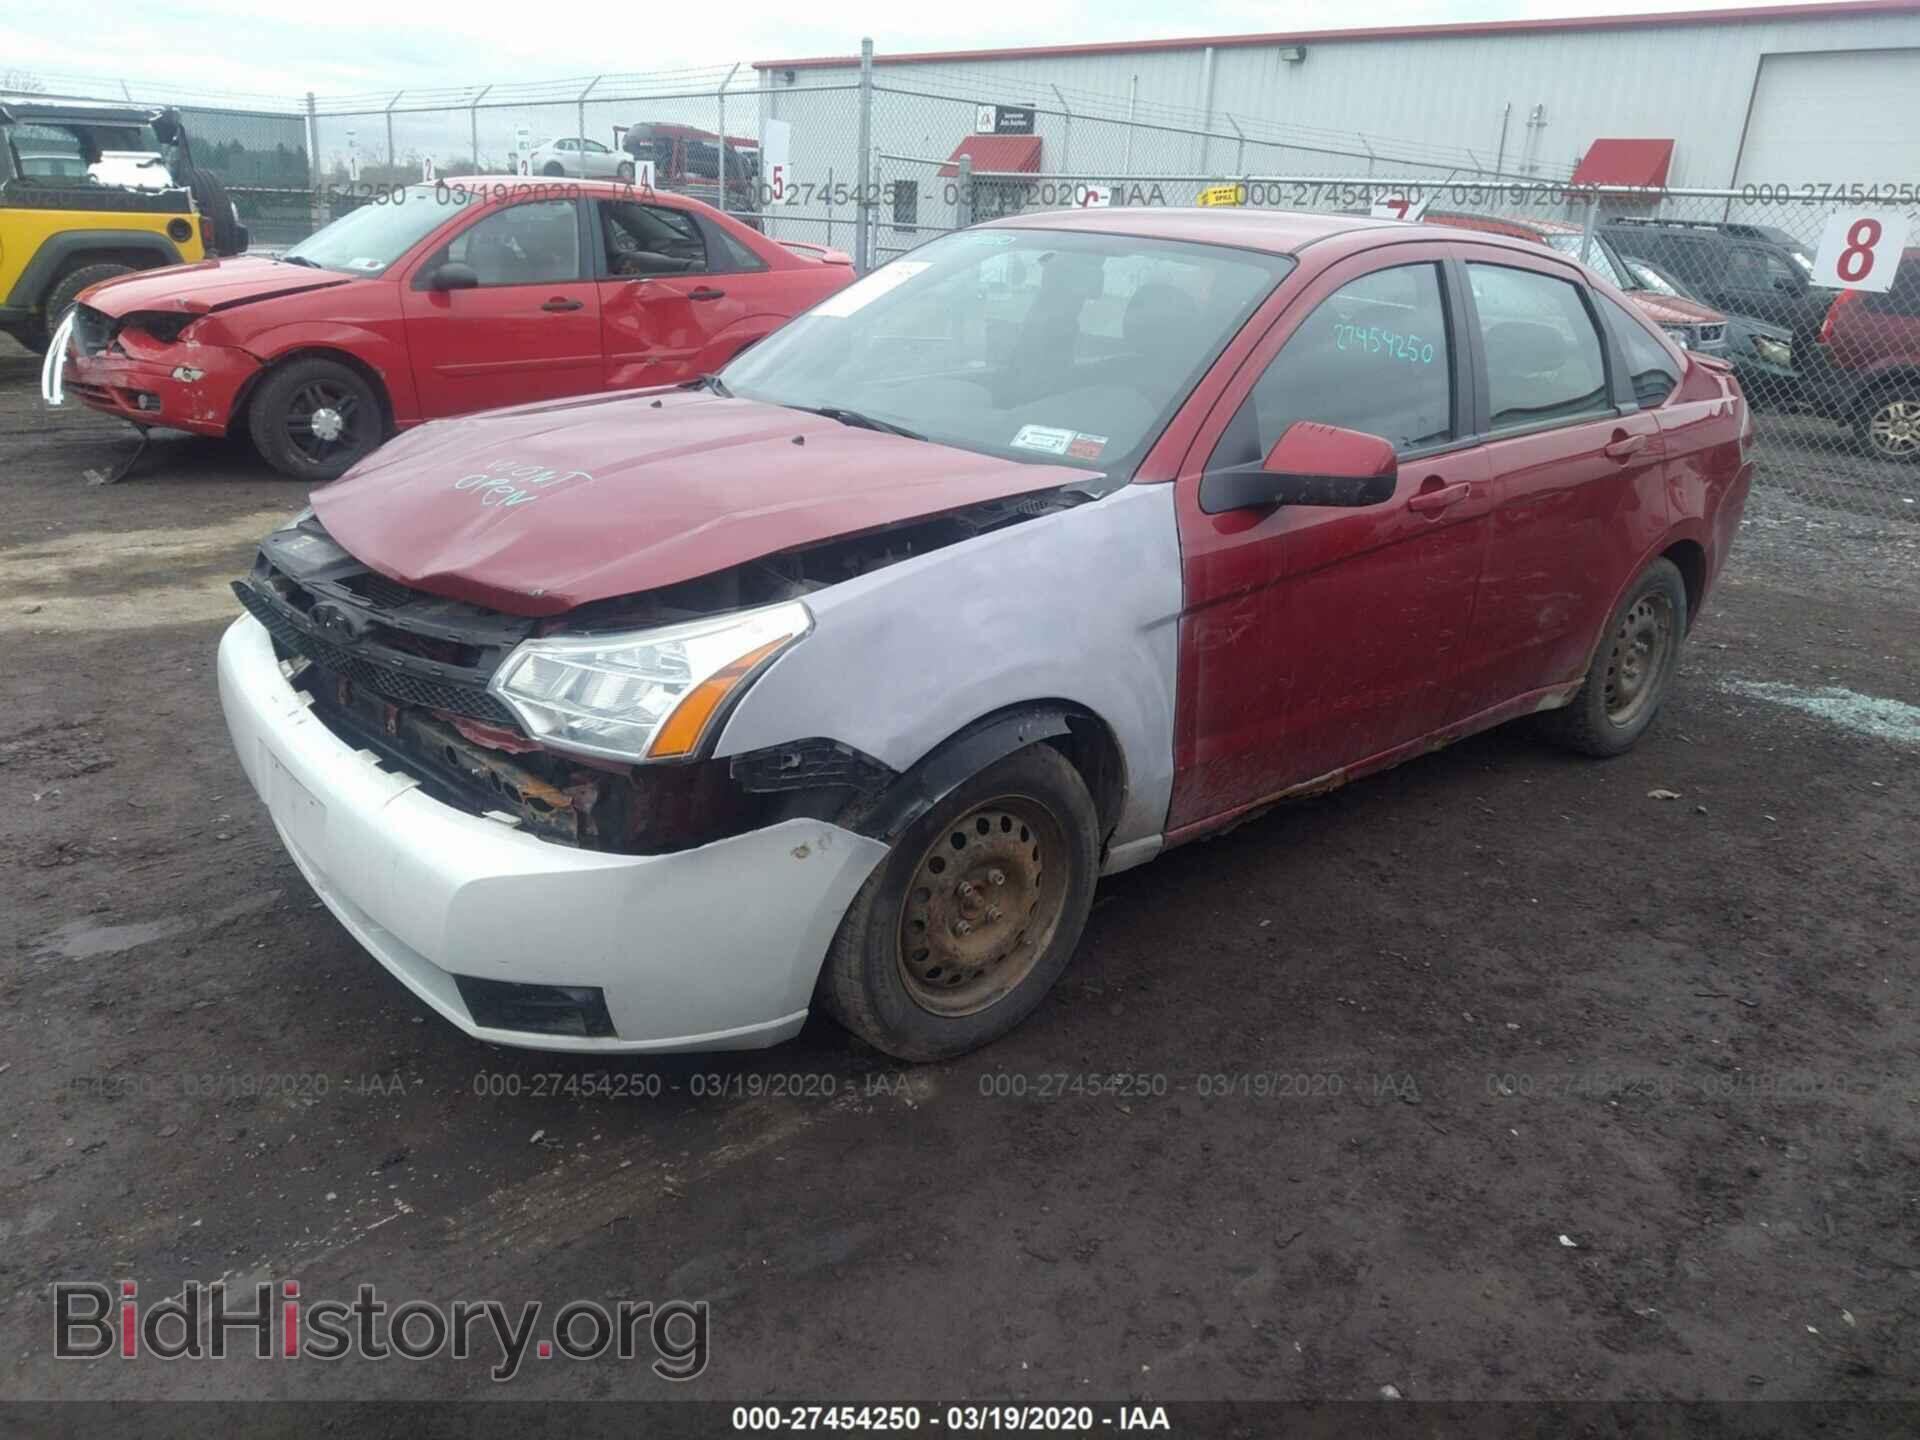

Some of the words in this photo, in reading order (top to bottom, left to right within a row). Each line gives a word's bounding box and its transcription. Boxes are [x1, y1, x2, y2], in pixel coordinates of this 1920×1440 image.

[773, 166, 784, 200] 5
[1387, 199, 1409, 219] 7
[1836, 218, 1882, 282] 8
[1334, 324, 1433, 363] 27454250
[455, 474, 538, 507] OPEN
